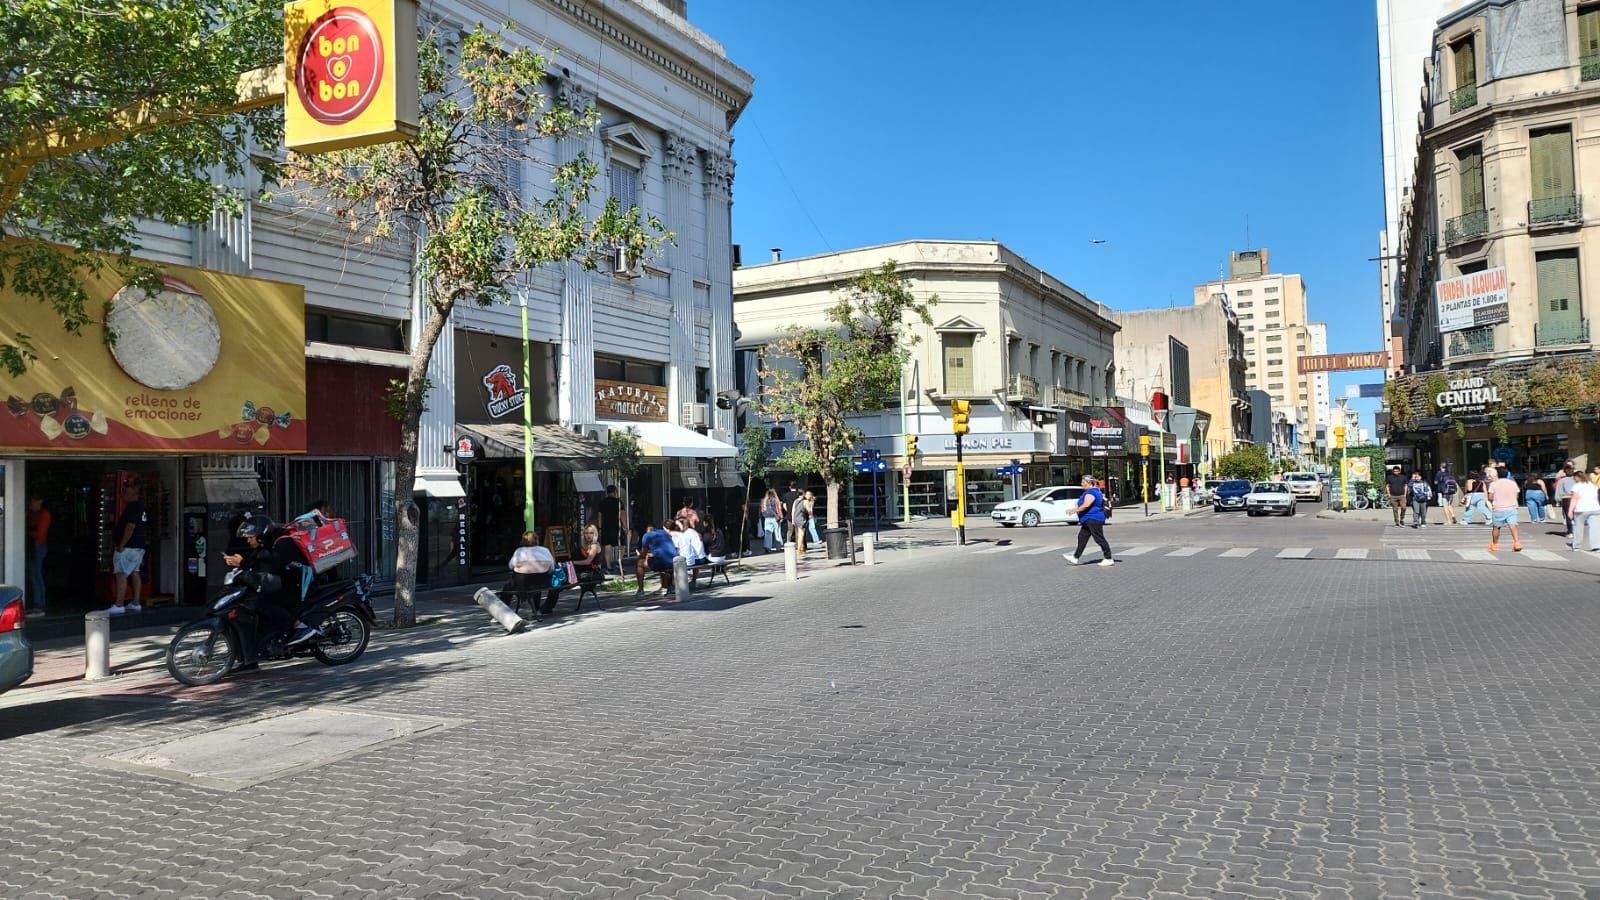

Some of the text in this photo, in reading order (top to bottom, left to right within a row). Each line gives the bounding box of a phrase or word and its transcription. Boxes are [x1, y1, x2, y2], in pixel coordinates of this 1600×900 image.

[319, 34, 359, 58] bon
[333, 60, 346, 77] o
[319, 80, 360, 102] bon
[1439, 280, 1465, 302] VENDEN
[1472, 270, 1505, 296] ALQUILAN
[1446, 299, 1471, 312] PLANTAS
[1472, 297, 1481, 306] DE
[1303, 357, 1337, 370] HOTEL
[1450, 377, 1484, 390] GRAND
[125, 393, 201, 409] relleno de
[598, 385, 657, 405] NATURAL
[1436, 386, 1502, 407] CENTRAL
[125, 408, 202, 421] emociones
[491, 399, 509, 414] ROCKY
[944, 437, 1012, 449] LEMON PIE
